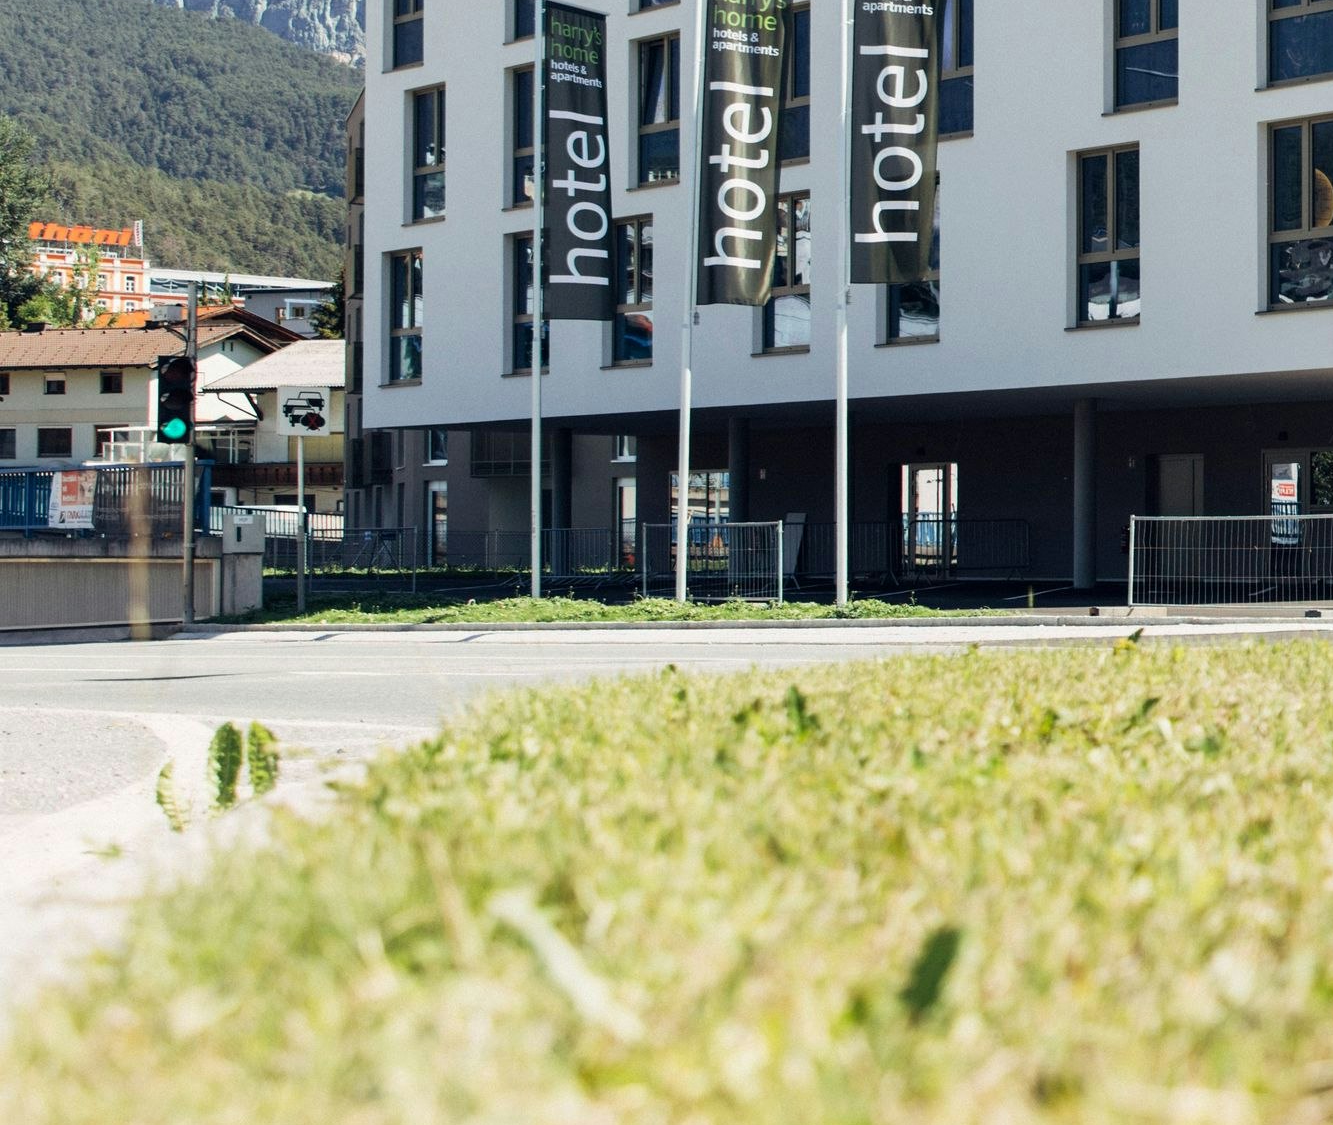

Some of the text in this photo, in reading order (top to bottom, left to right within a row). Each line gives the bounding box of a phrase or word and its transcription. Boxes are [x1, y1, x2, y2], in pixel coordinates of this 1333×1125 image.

[714, 4, 777, 31] home
[862, 2, 933, 15] apartments
[551, 16, 602, 47] harry's
[713, 28, 759, 42] hotels &
[551, 38, 598, 64] home
[712, 41, 779, 56] apartments
[550, 71, 602, 88] apartments
[551, 59, 587, 75] hotels &
[854, 45, 928, 243] hotel
[704, 81, 774, 269] hotel
[549, 110, 609, 286] hotel
